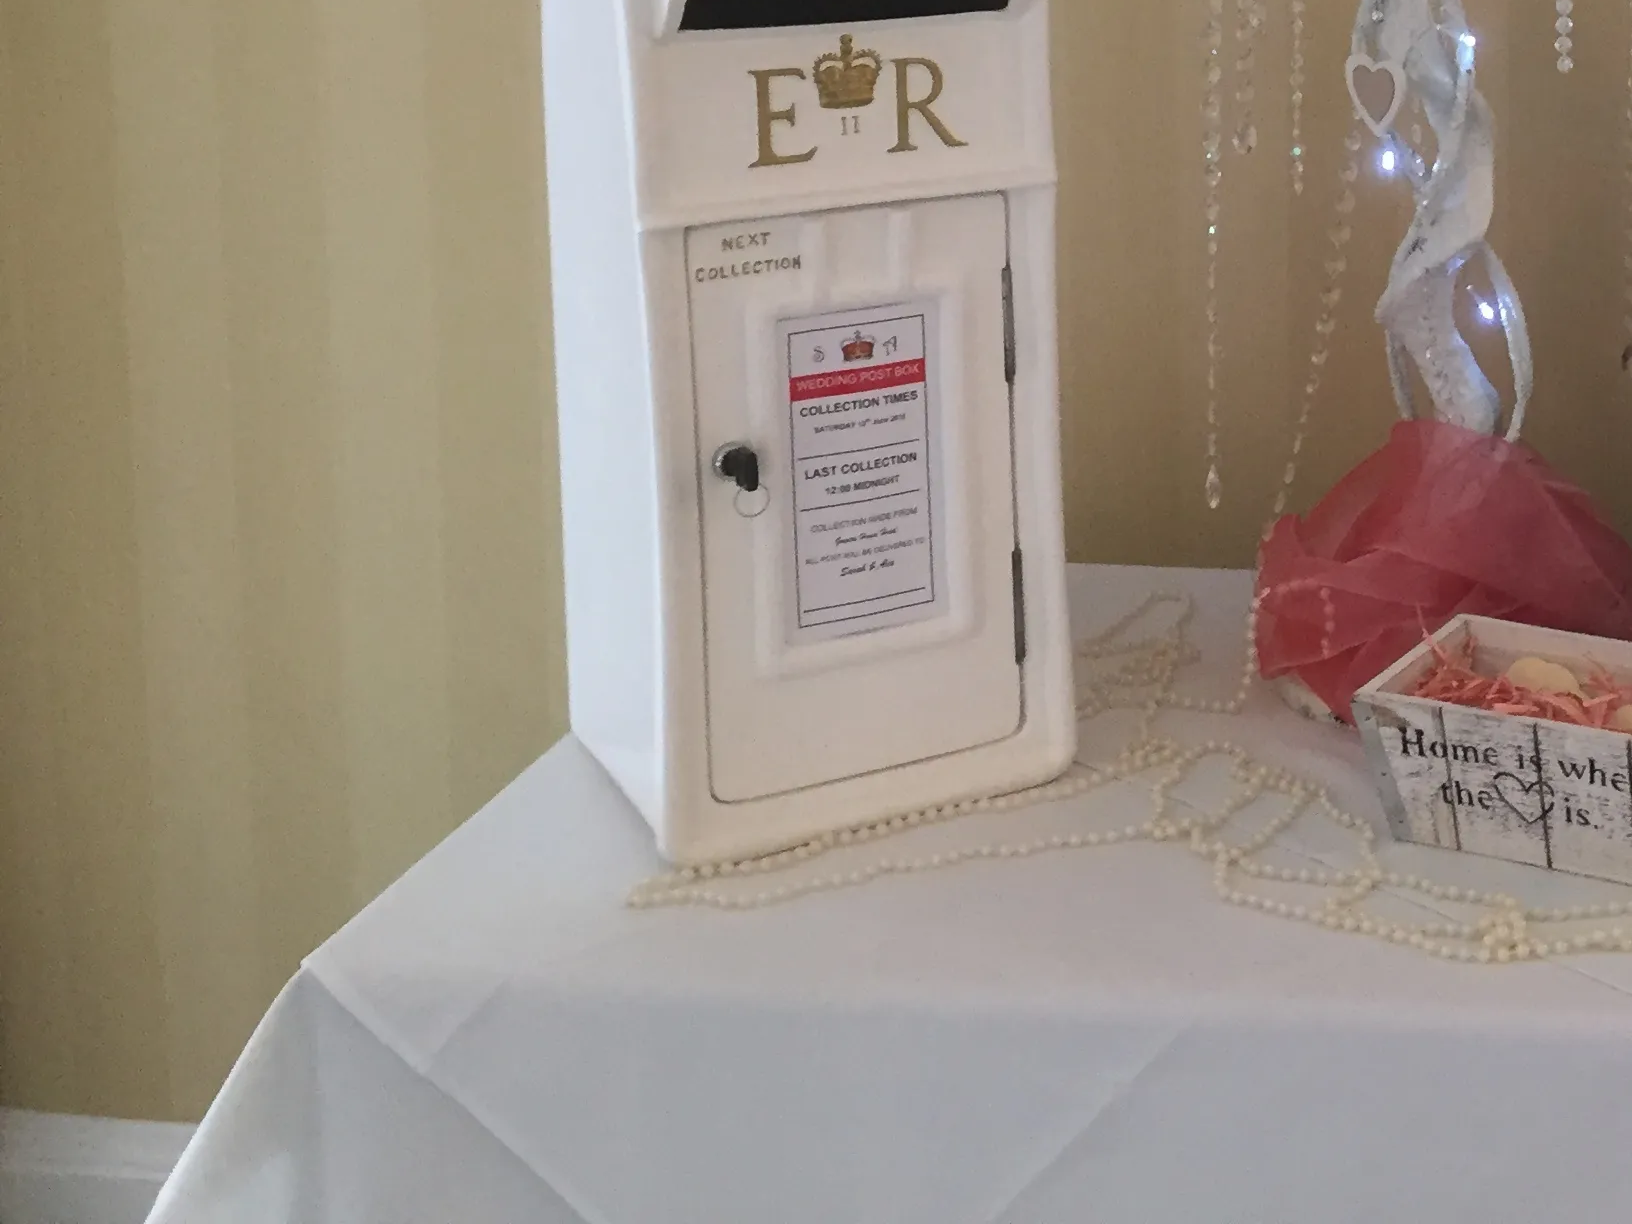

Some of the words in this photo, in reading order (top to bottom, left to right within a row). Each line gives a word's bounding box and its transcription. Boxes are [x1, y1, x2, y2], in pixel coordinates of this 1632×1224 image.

[747, 68, 818, 169] E
[887, 57, 969, 153] R
[721, 232, 771, 252] NEXT
[694, 255, 802, 283] COLLECTION
[812, 345, 825, 363] S
[882, 335, 898, 356] A
[796, 373, 857, 392] WEDDING
[859, 367, 893, 384] POST
[894, 363, 920, 377] BOX
[799, 397, 880, 418] COLLECTION
[882, 390, 919, 405] TIMES
[813, 421, 856, 434] SATURDAY
[804, 465, 837, 481] LAST
[840, 452, 918, 475] COLLECTION
[824, 483, 852, 495] 12:00
[853, 474, 901, 491] MIDNIGHT
[810, 517, 867, 533] COLLECTION
[868, 511, 891, 524] MADE
[893, 507, 918, 519] FROM
[819, 553, 842, 563] POST
[873, 539, 914, 554] DELIVERED
[1397, 727, 1498, 766] Home
[1516, 744, 1542, 772] is
[1440, 781, 1495, 811] the
[1562, 796, 1600, 830] is.
